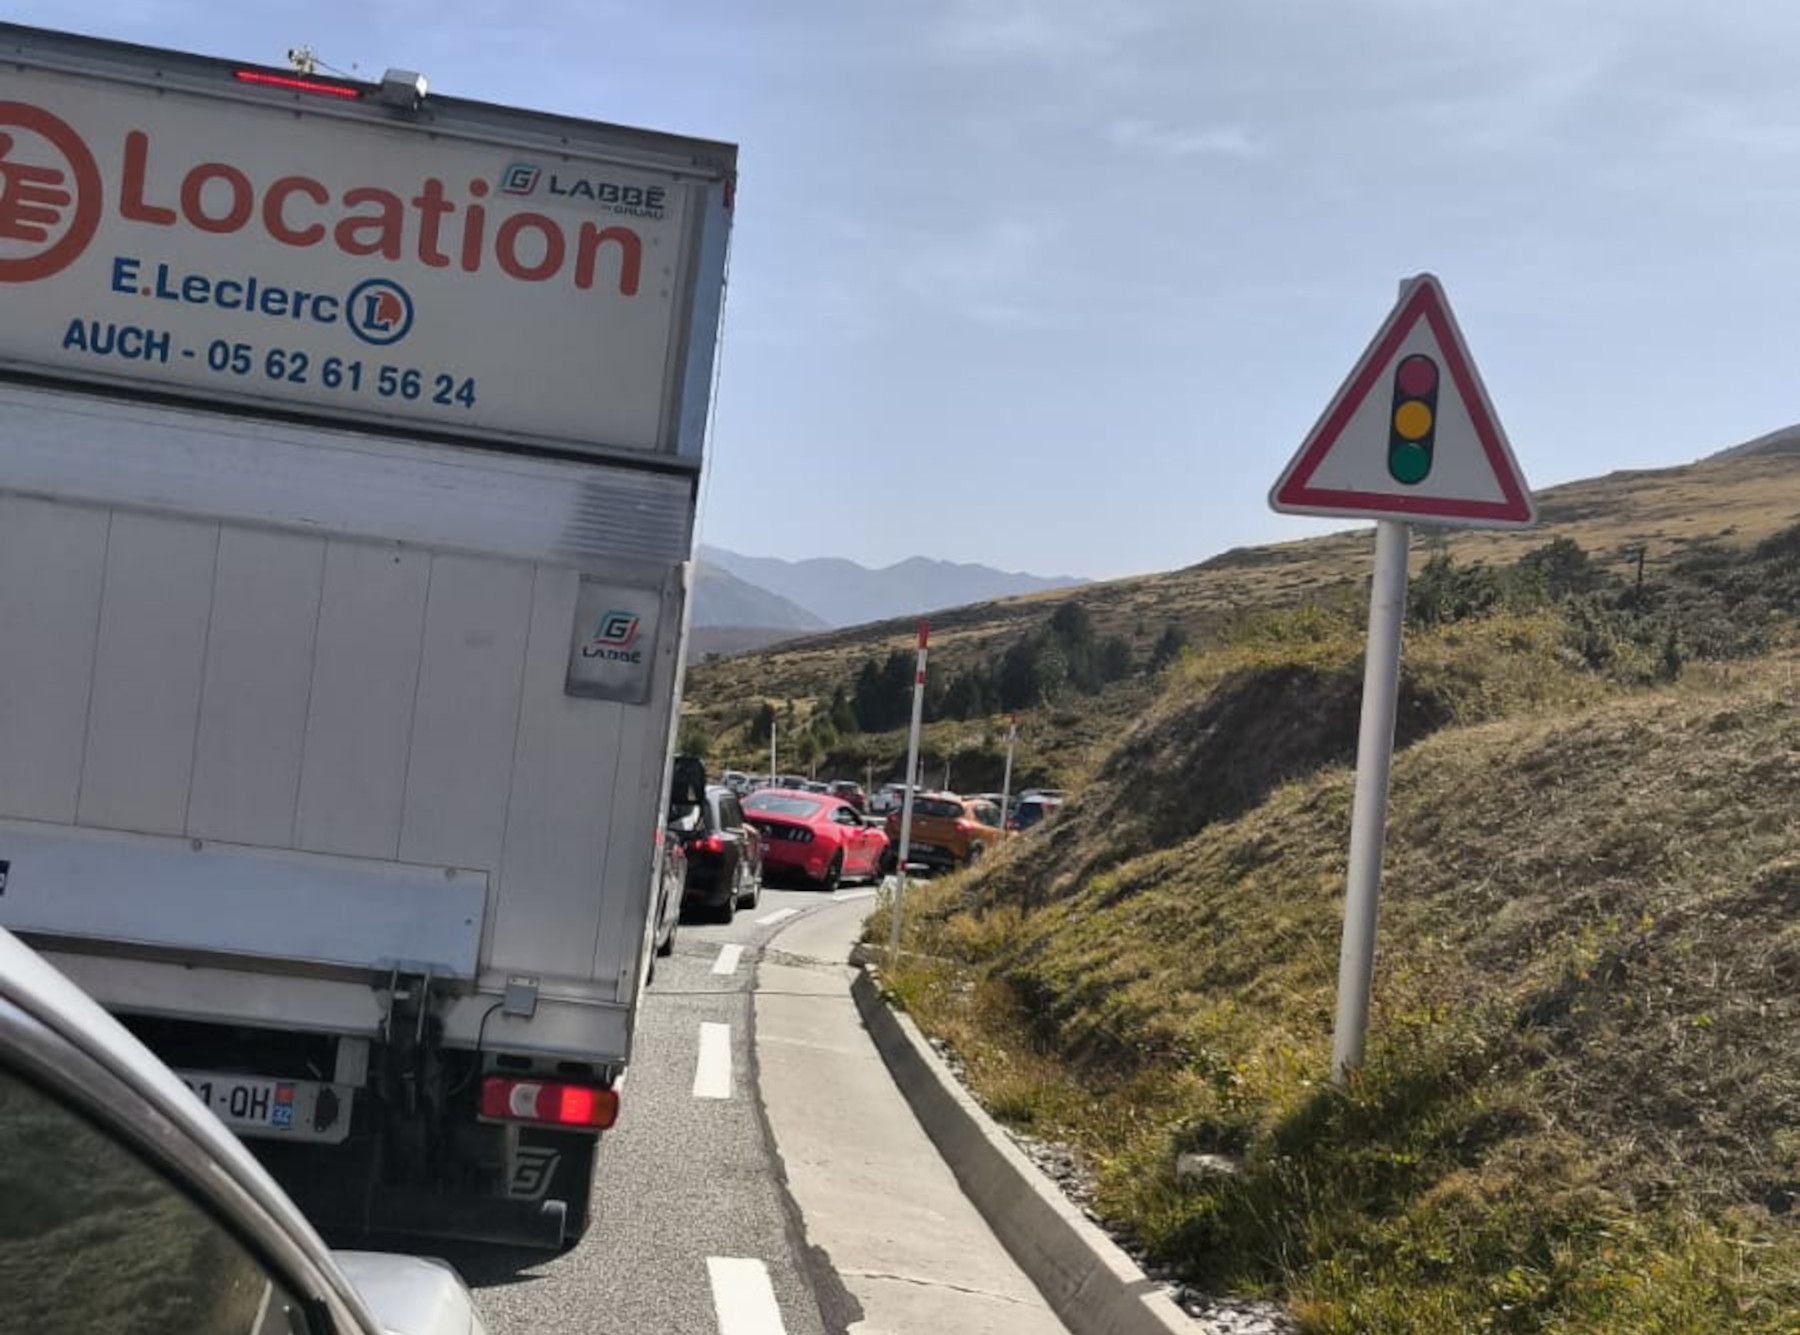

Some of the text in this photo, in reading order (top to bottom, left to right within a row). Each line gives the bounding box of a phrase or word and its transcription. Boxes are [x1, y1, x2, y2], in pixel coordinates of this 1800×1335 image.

[119, 129, 643, 298] Location
[110, 255, 340, 325] E.Leclerc
[62, 318, 170, 364] AUCH
[207, 339, 252, 375] 05
[265, 349, 309, 384] 62
[321, 357, 363, 391] 61
[377, 366, 423, 400] 56
[432, 373, 477, 409] 24
[184, 1080, 271, 1121] 1-QH
